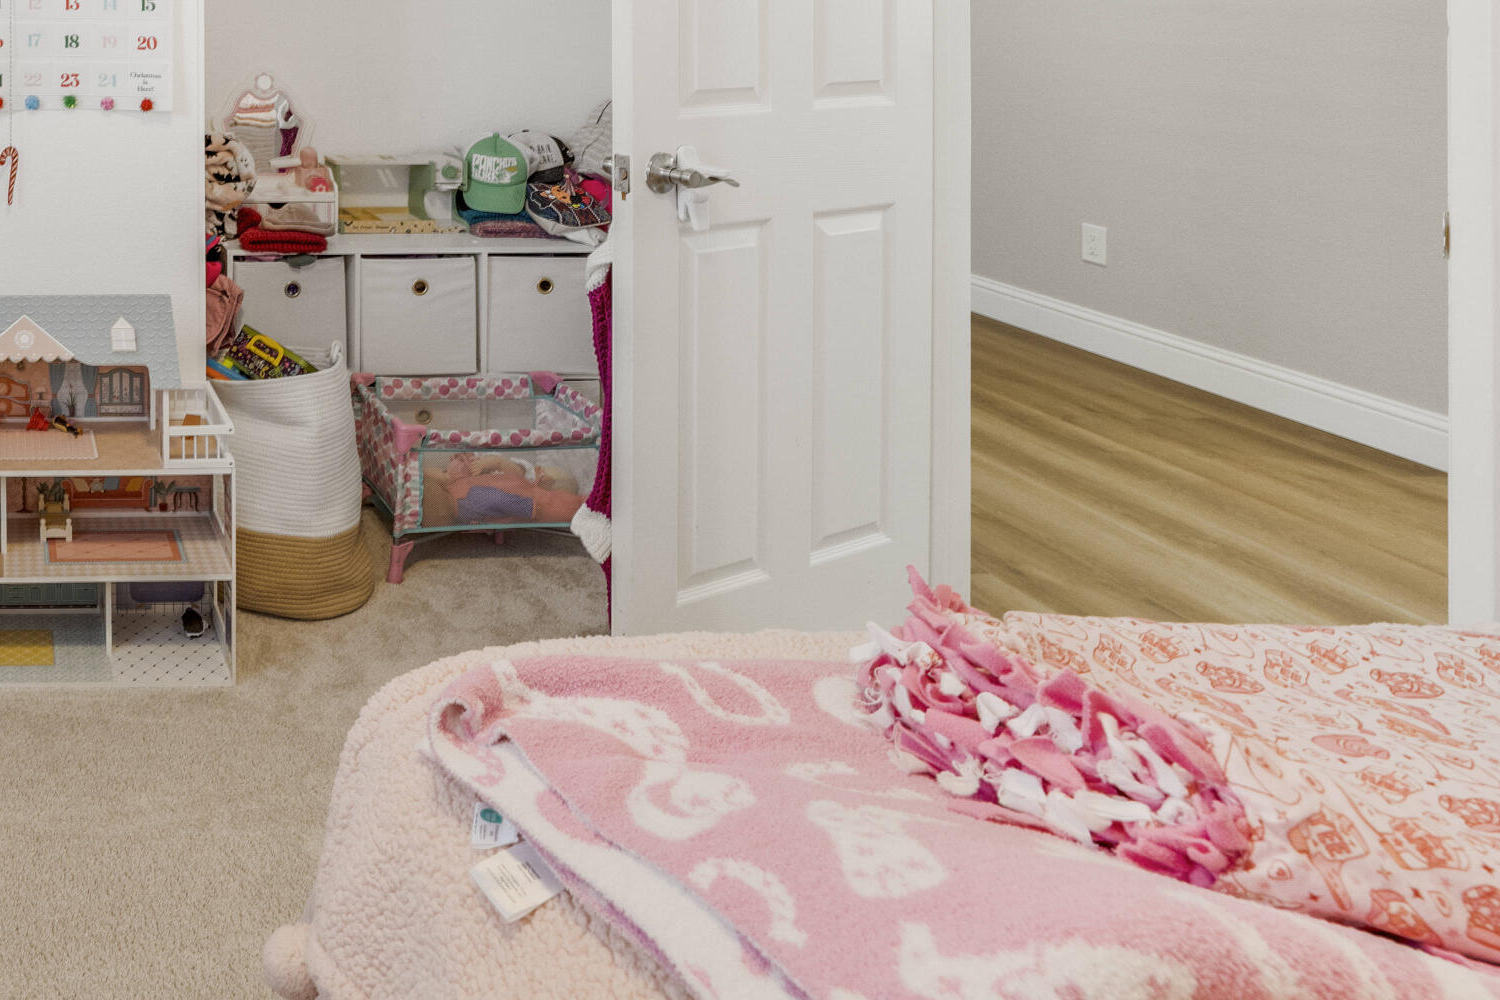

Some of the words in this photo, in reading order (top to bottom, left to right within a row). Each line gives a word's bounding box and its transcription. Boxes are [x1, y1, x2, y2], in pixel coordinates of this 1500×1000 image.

[28, 33, 41, 48] 17
[64, 34, 79, 48] 18
[102, 35, 117, 48] 19
[137, 36, 158, 50] 20
[24, 73, 42, 87] 22
[60, 73, 80, 88] 23
[98, 73, 117, 87] 24
